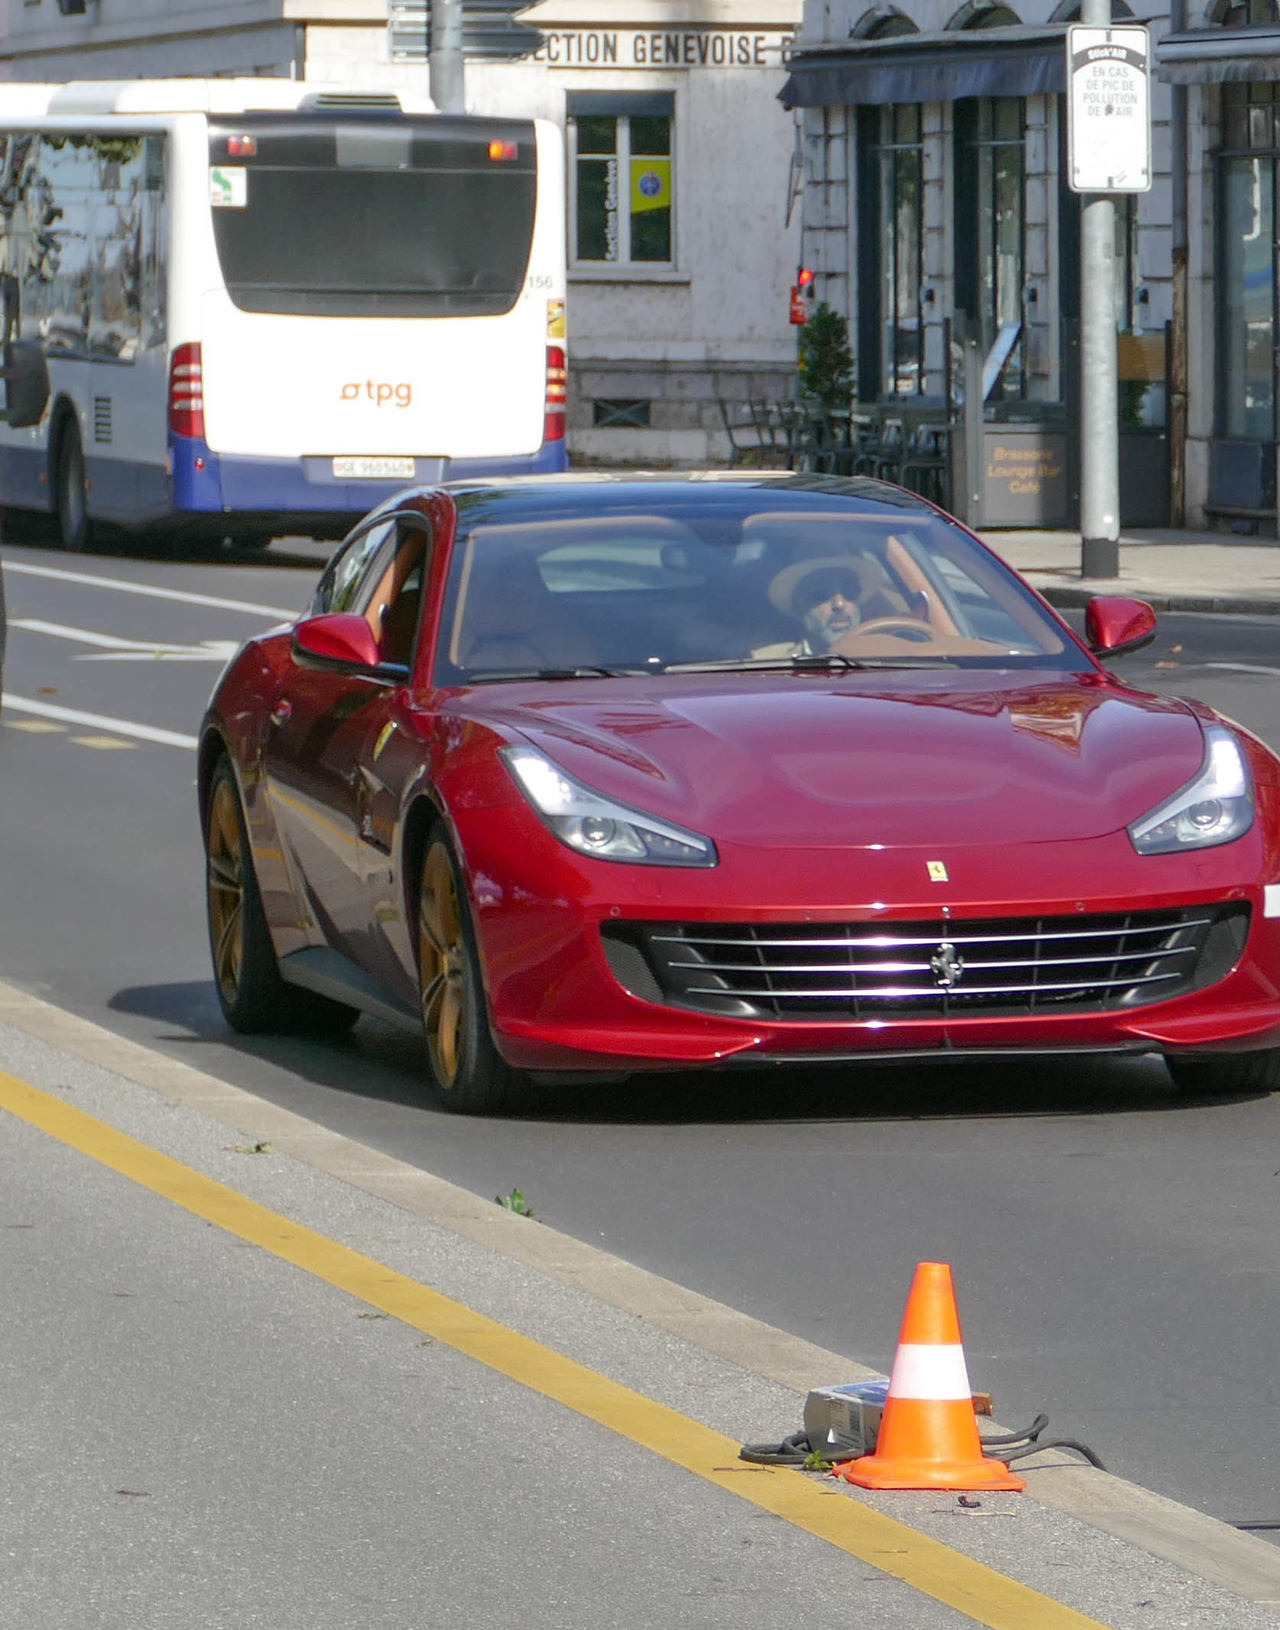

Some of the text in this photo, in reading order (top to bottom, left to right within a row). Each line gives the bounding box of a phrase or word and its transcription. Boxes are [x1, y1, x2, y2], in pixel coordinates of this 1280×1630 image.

[519, 34, 618, 62] CTION
[633, 35, 767, 64] GENEVOISE
[1092, 67, 1129, 77] EN CAS
[1086, 80, 1135, 91] DE PIC DE
[1083, 93, 1138, 104] POLLUTION
[1088, 106, 1100, 116] DE
[988, 465, 1036, 479] Lounge
